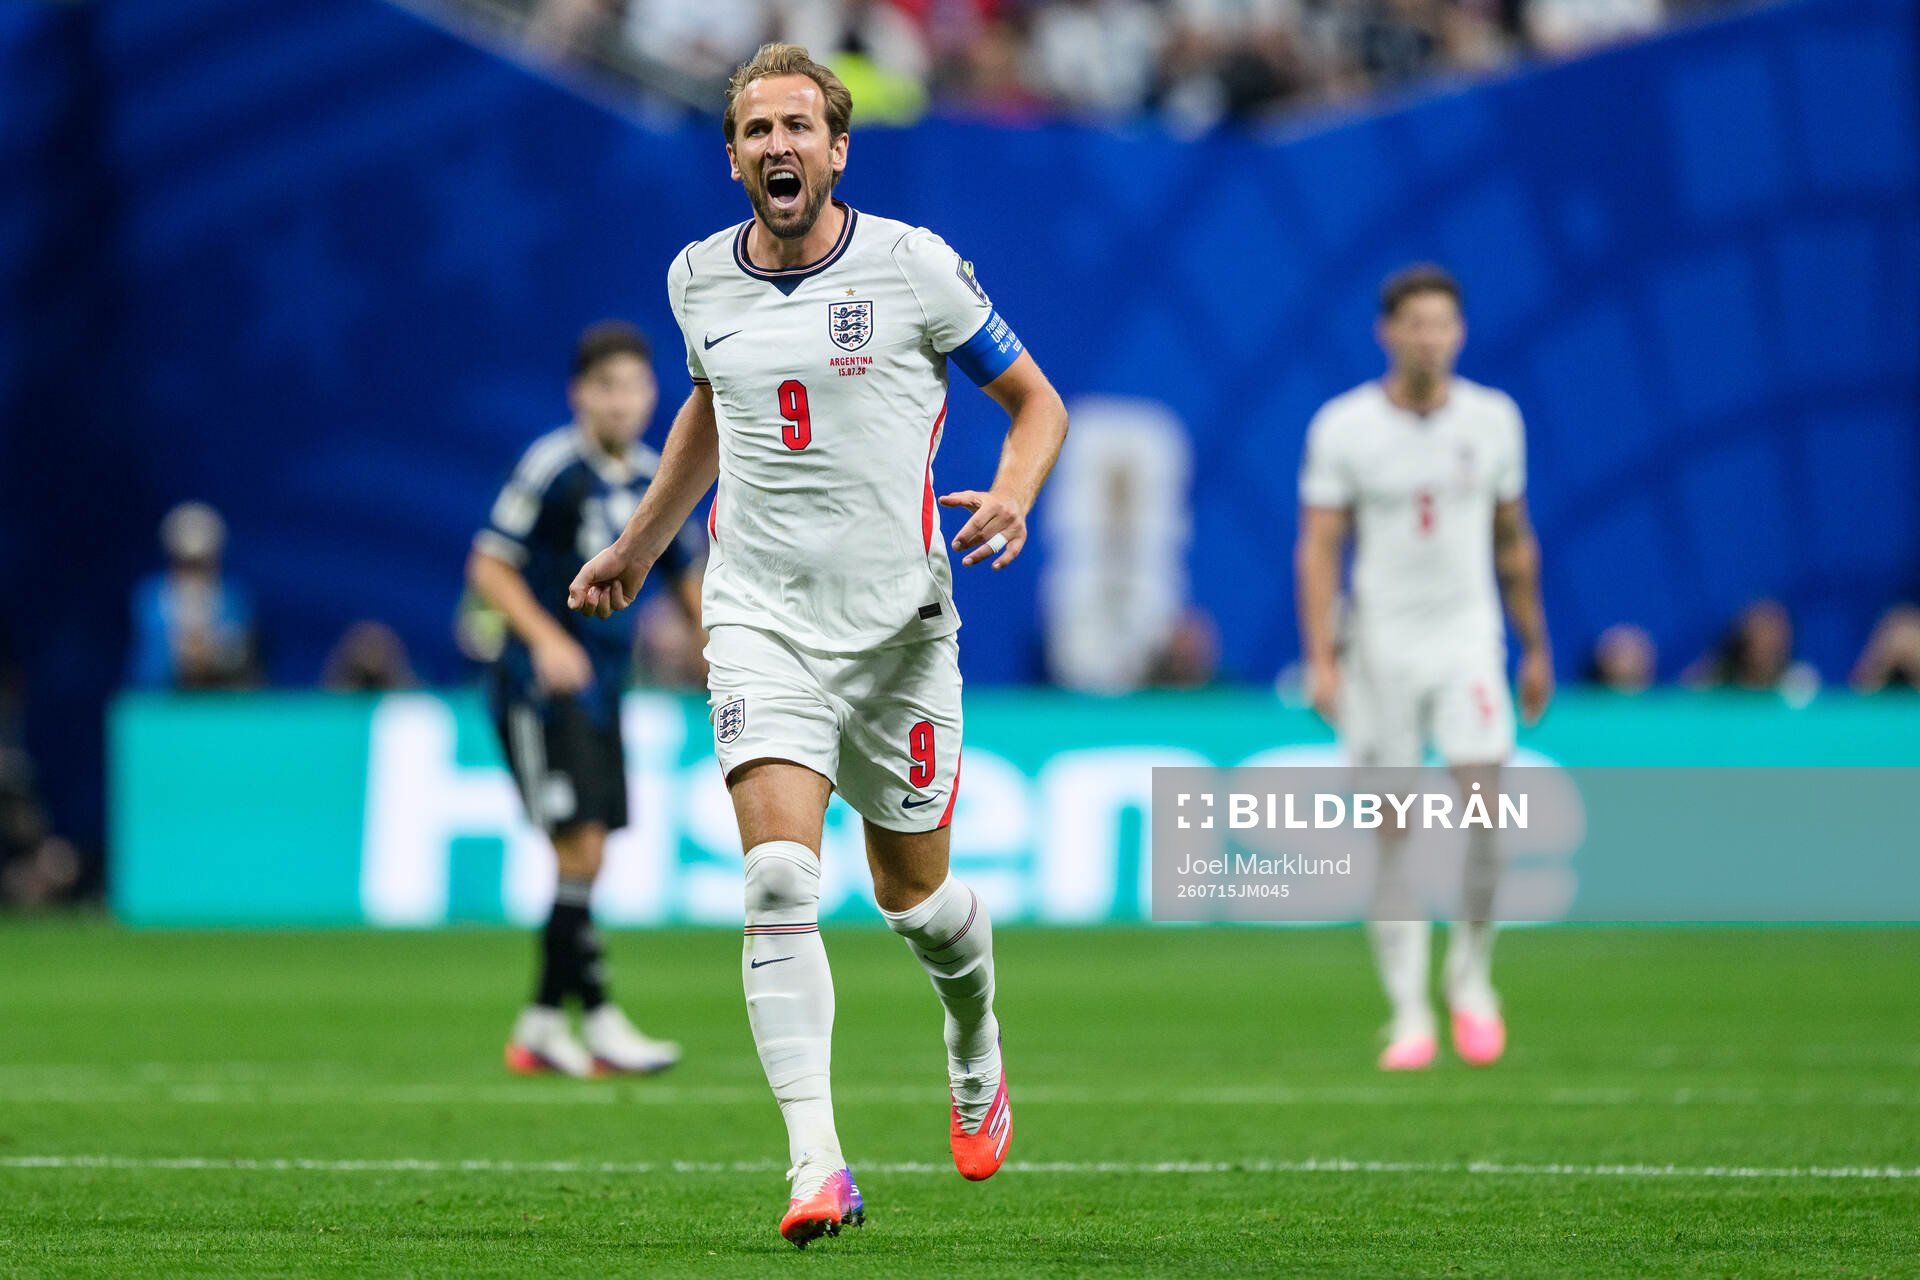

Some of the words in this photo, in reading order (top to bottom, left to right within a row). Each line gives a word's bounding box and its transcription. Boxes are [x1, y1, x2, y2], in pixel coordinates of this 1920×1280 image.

[829, 356, 873, 367] ARGENTINA
[777, 379, 812, 450] 9
[908, 720, 936, 789] 9
